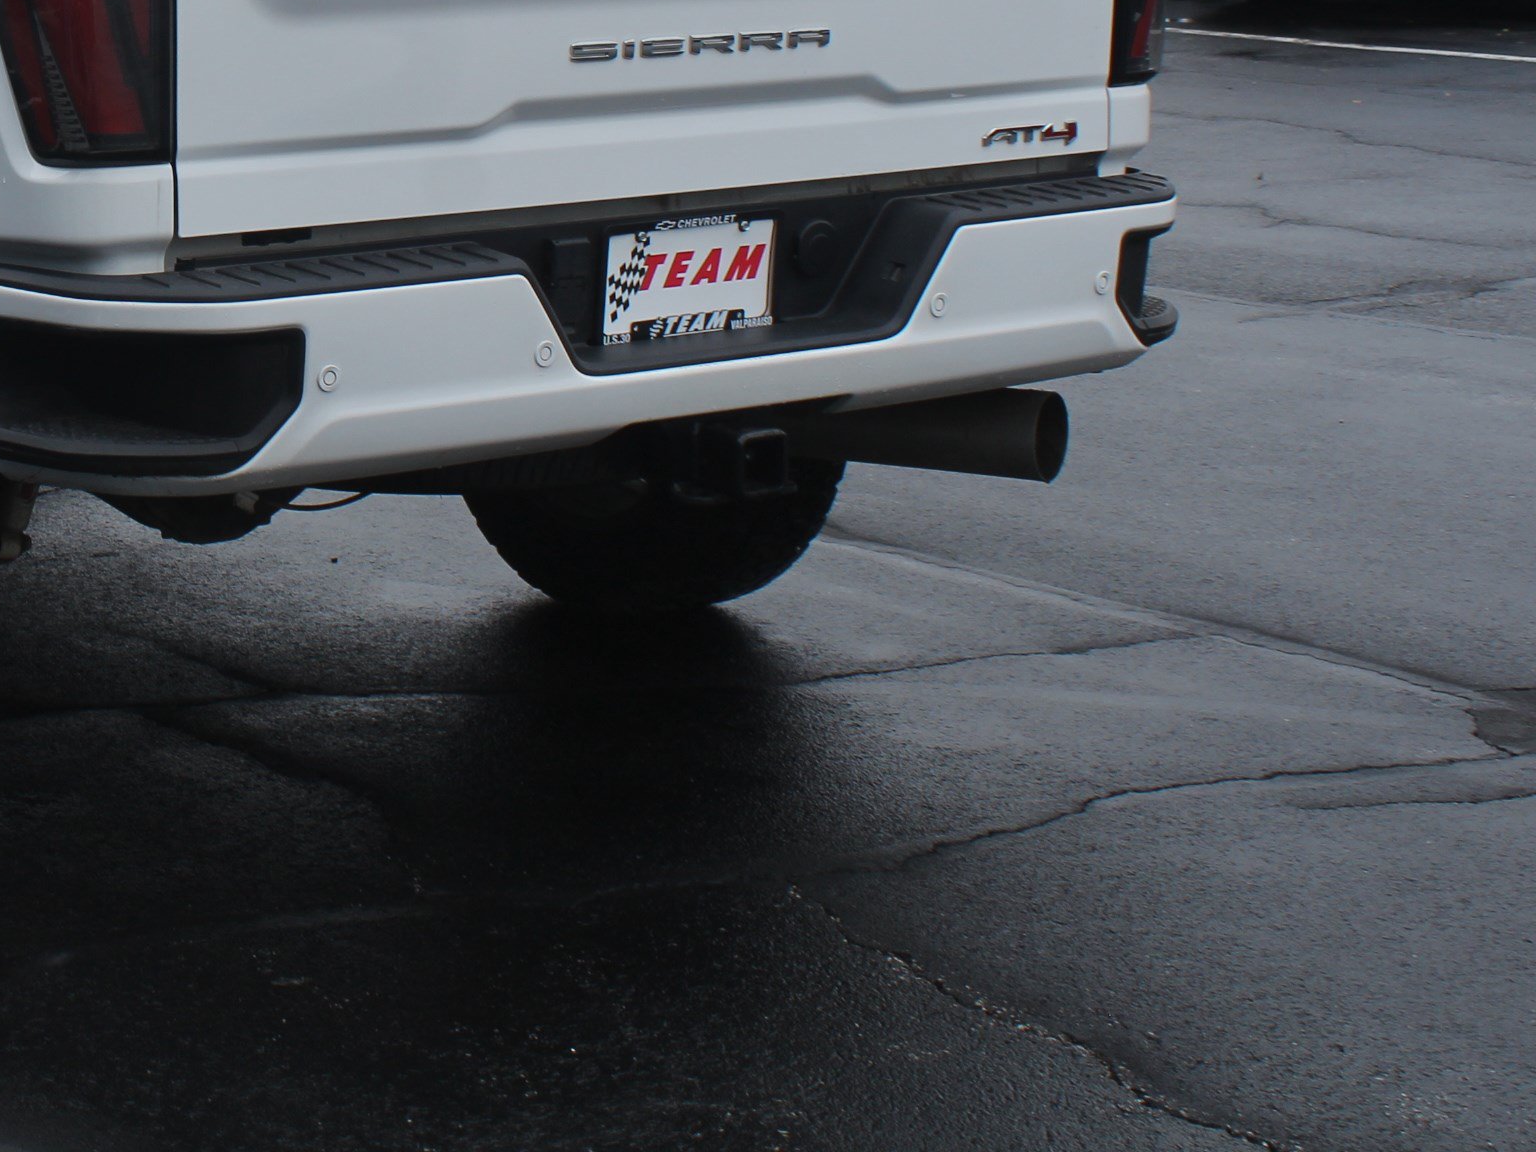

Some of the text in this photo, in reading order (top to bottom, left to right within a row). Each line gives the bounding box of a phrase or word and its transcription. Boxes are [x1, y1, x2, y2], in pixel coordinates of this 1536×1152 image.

[569, 27, 831, 63] SIERRA
[981, 120, 1078, 147] AT4
[677, 214, 737, 228] CHEVROLET
[639, 244, 767, 291] TEAM
[663, 310, 729, 336] TEAM
